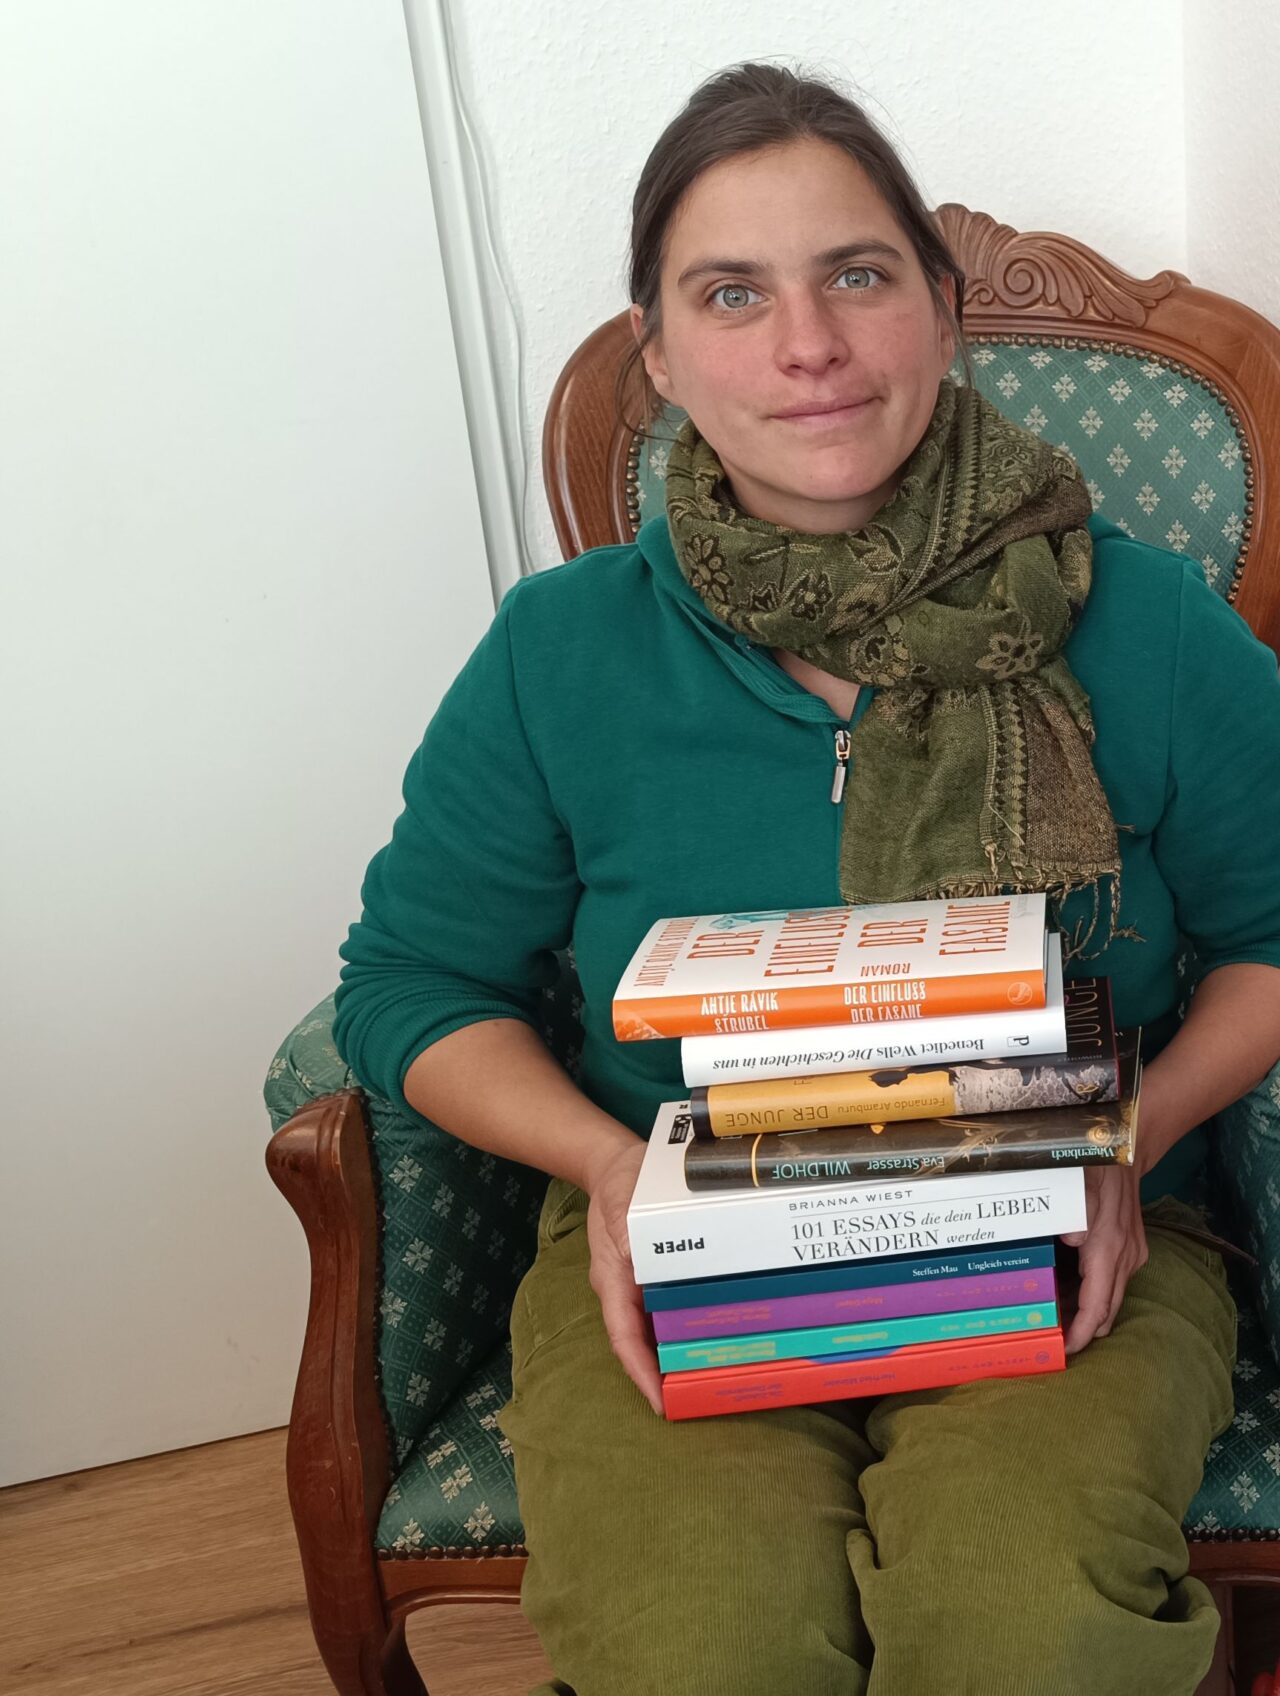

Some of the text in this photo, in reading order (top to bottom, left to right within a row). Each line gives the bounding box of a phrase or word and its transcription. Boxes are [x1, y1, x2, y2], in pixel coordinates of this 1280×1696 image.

[857, 918, 929, 948] DER
[939, 901, 1011, 955] FASANE
[687, 930, 764, 959] DER
[861, 963, 911, 977] ROMAN
[701, 987, 779, 1018] ANTJE RÁVIK
[843, 981, 926, 1006] DER EINFLUSS
[715, 1015, 770, 1033] STRUBEL
[850, 1003, 923, 1024] DER FASANE
[712, 1036, 985, 1070] Benedict Wells Die Geschichten in uns
[837, 1096, 946, 1114] Fernando Aramburu
[725, 1105, 829, 1128] DER JUNGE
[866, 1155, 946, 1171] Eva Strasser
[1051, 1145, 1117, 1160] Wagenbach
[772, 1159, 852, 1180] WILDHOF
[789, 1189, 914, 1211] BRIANNA WIEST
[792, 1195, 1052, 1241] 101 ESSAYS die dein LEBEN
[652, 1236, 705, 1255] PIPER
[792, 1227, 996, 1263] VERÄNDERN werden
[912, 1264, 959, 1278] Steffen Mau
[967, 1256, 1030, 1273] Ungleich vereint
